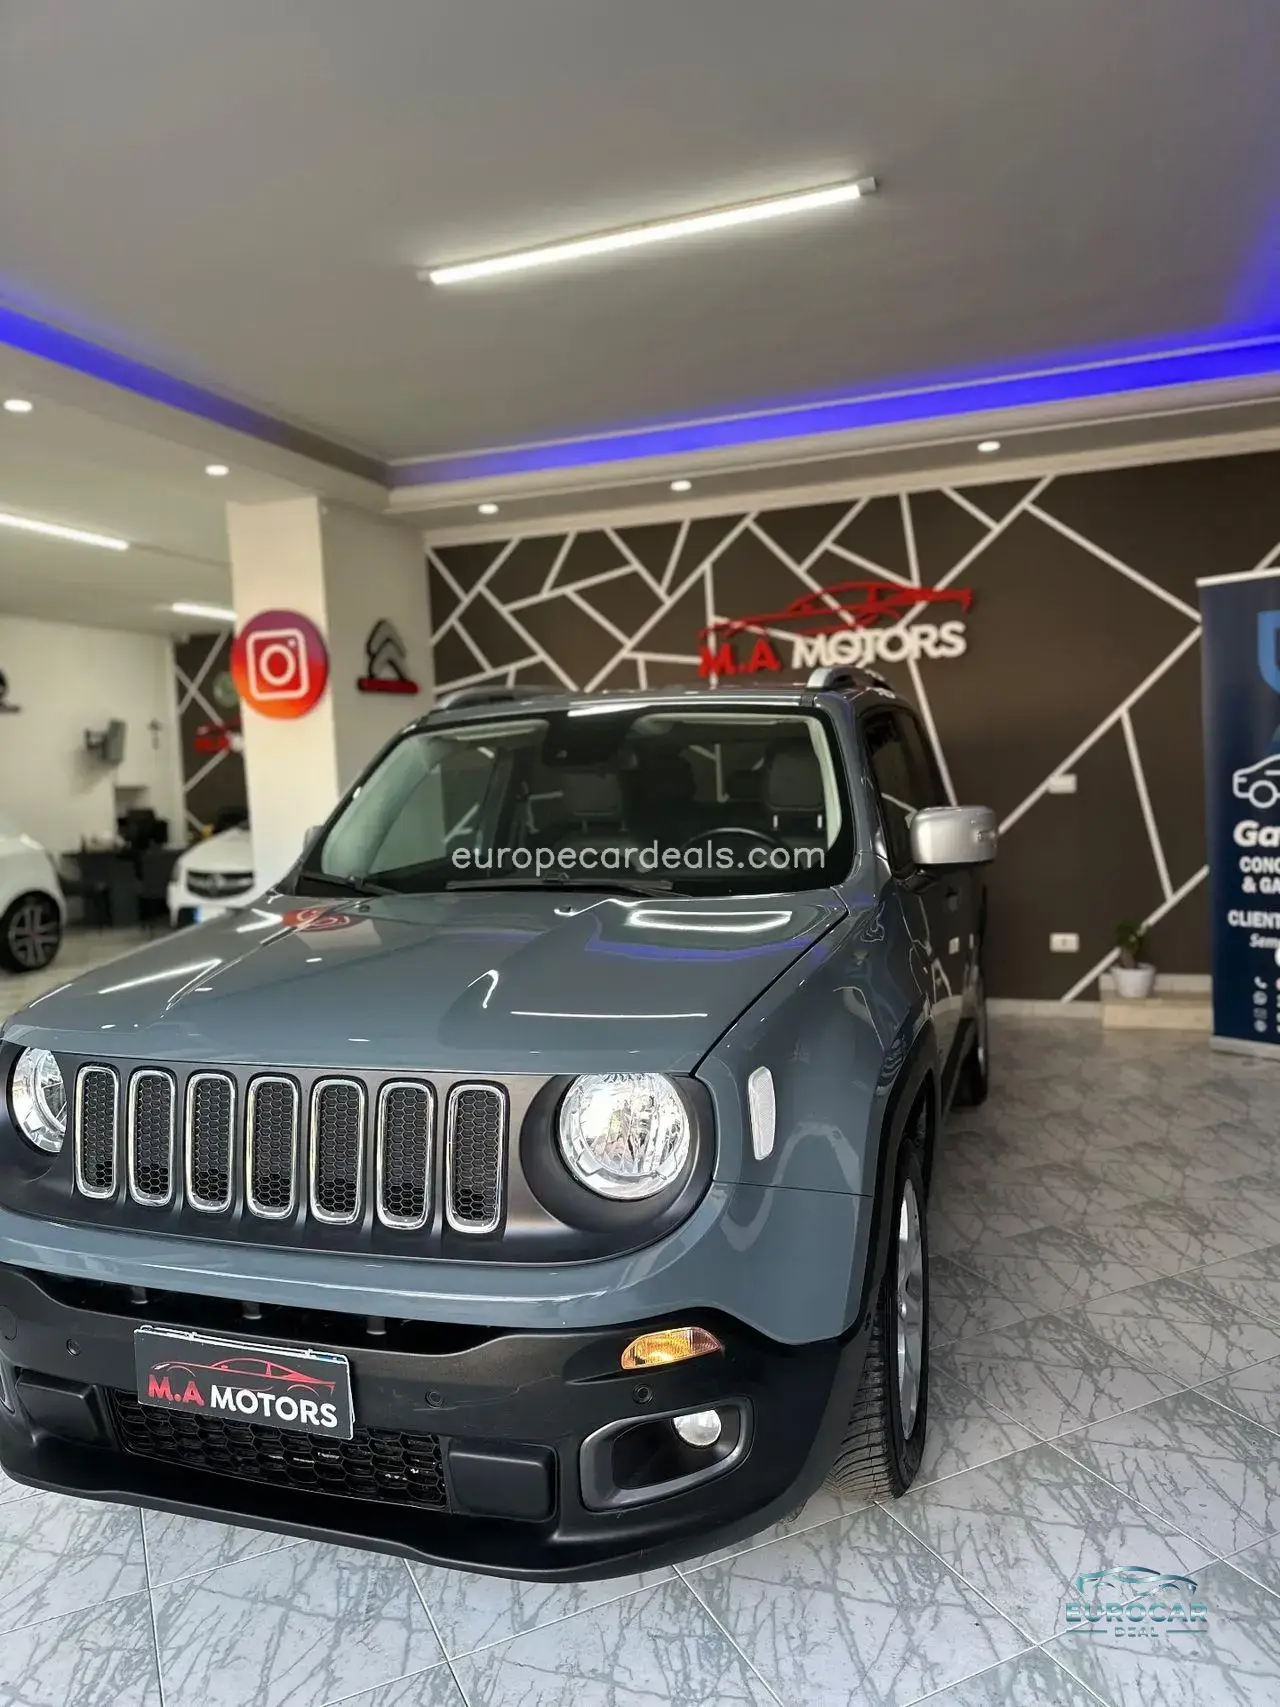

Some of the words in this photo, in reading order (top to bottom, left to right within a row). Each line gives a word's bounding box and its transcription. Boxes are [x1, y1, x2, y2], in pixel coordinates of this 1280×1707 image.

[698, 638, 782, 678] M.A
[791, 620, 967, 669] MOTORS
[1242, 875, 1256, 893] &
[148, 1374, 205, 1406] M.A
[210, 1384, 338, 1428] MOTORS
